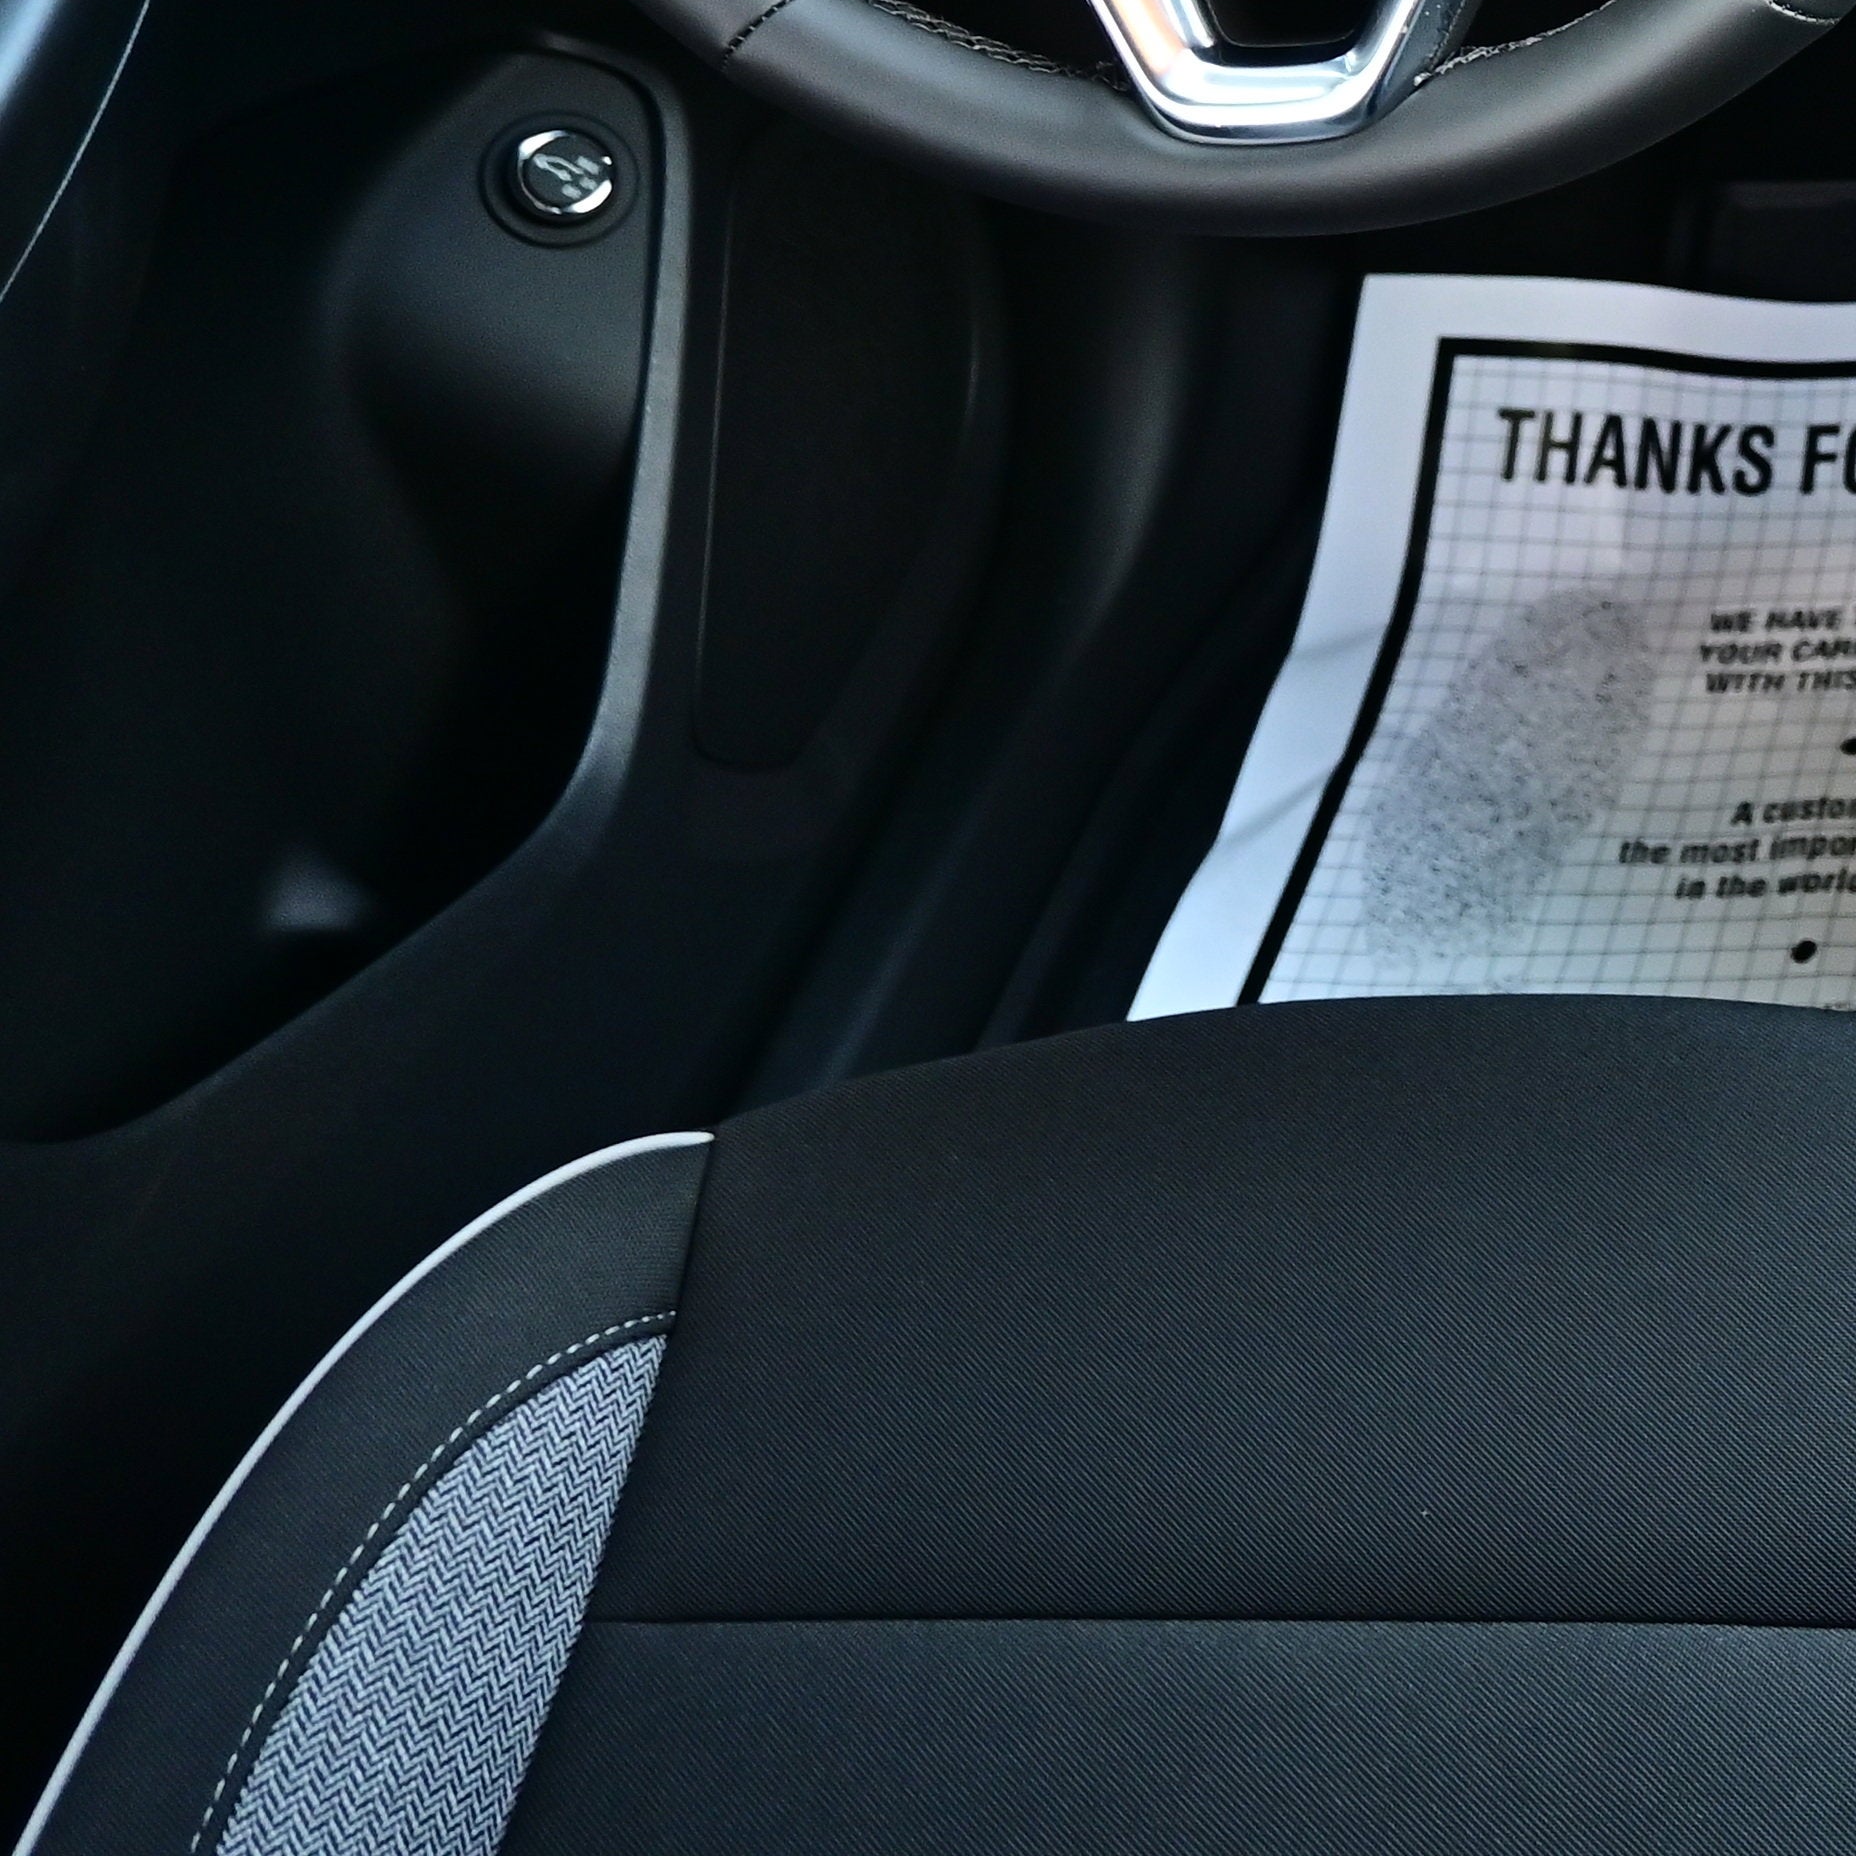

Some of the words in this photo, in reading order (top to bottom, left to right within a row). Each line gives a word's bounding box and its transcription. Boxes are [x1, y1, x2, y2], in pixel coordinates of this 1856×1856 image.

[1497, 407, 1776, 496] THANKS
[1710, 611, 1757, 633] WE
[1765, 606, 1843, 631] HAVE
[1699, 641, 1783, 665] YOUR
[1705, 671, 1784, 693] WITH
[1731, 800, 1753, 826] A
[1619, 841, 1670, 865] the
[1680, 836, 1759, 863] most
[1675, 877, 1706, 899] in
[1716, 874, 1767, 898] the
